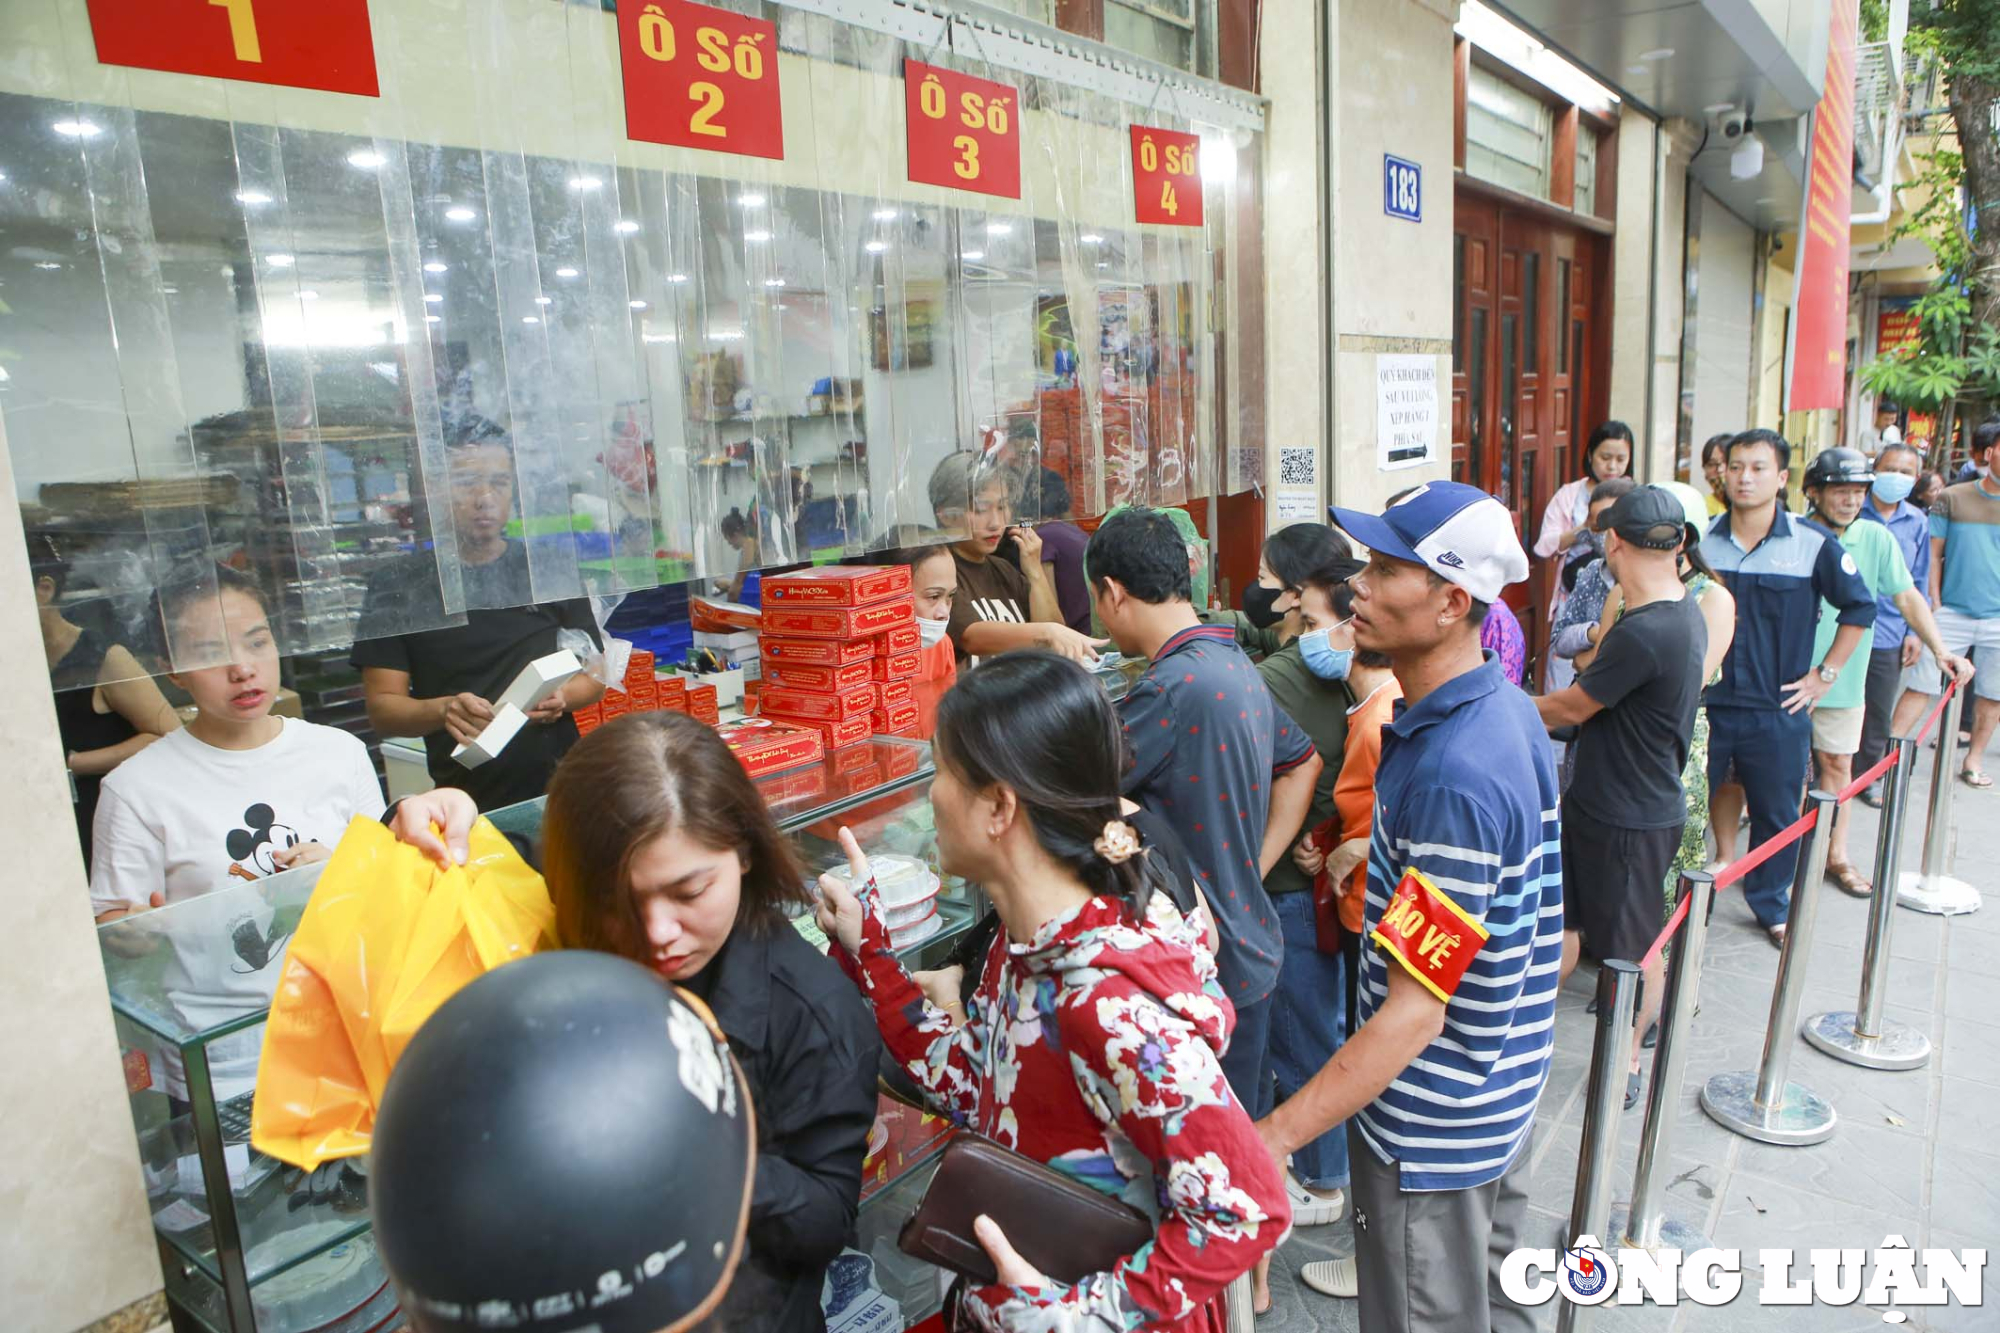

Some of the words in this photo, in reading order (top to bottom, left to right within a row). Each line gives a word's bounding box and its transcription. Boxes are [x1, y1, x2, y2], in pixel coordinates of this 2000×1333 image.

[207, 0, 262, 63] 1
[638, 4, 676, 61] Ô
[689, 81, 727, 137] 2
[920, 73, 946, 119] Ô
[953, 135, 980, 180] 3
[1141, 135, 1157, 172] Ô
[1161, 180, 1178, 216] 4
[1389, 165, 1417, 213] 183
[1443, 551, 1464, 566] NIKE
[1417, 924, 1460, 970] VỆ
